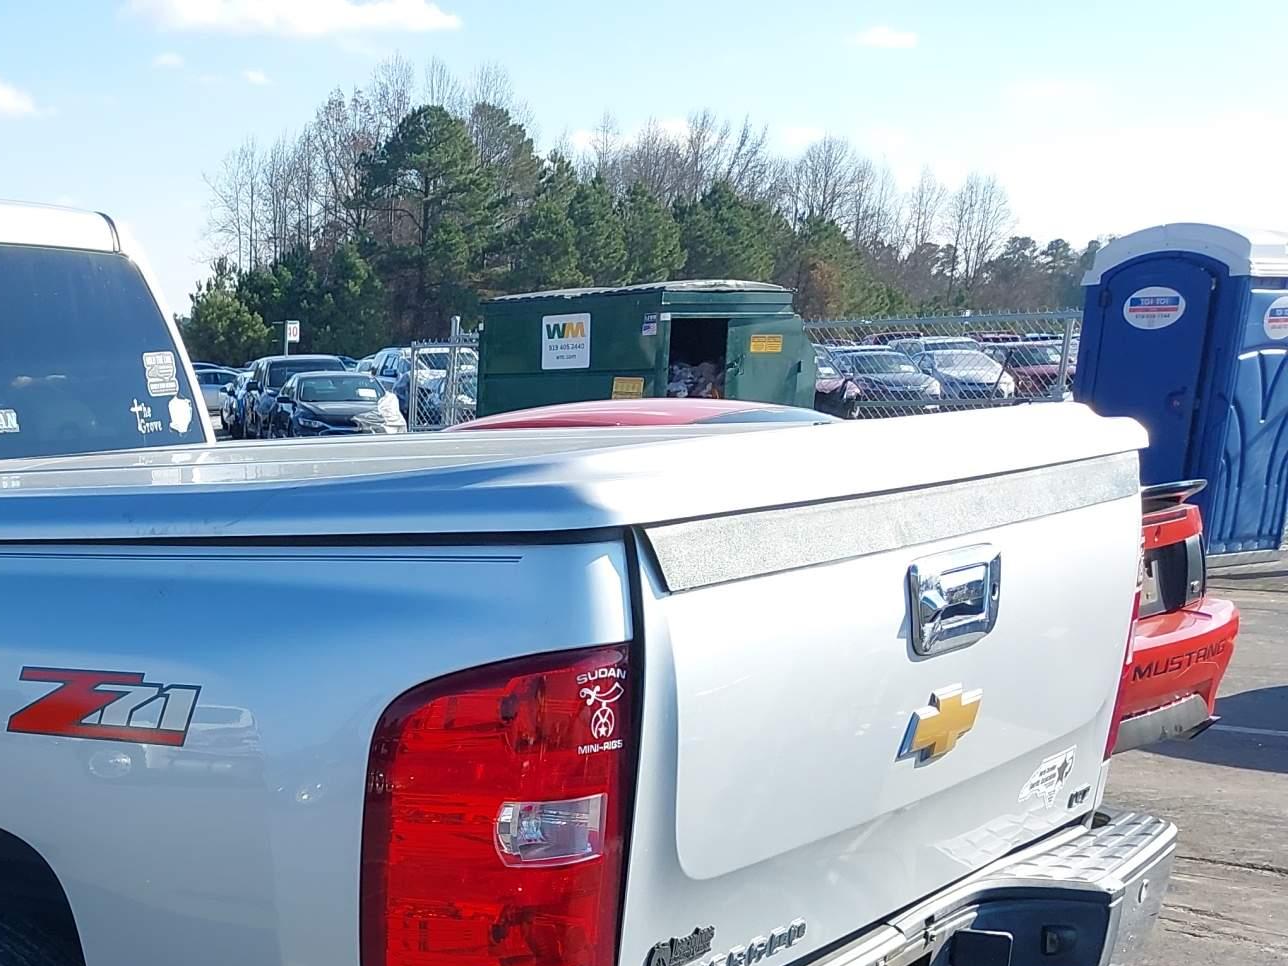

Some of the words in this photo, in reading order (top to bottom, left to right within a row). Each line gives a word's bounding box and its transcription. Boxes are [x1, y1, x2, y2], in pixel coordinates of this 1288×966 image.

[545, 322, 585, 339] WM
[1131, 639, 1226, 682] MUSTANG
[576, 667, 627, 685] SUDAN
[6, 665, 202, 747] Z71
[577, 739, 623, 755] MINI-RIGS
